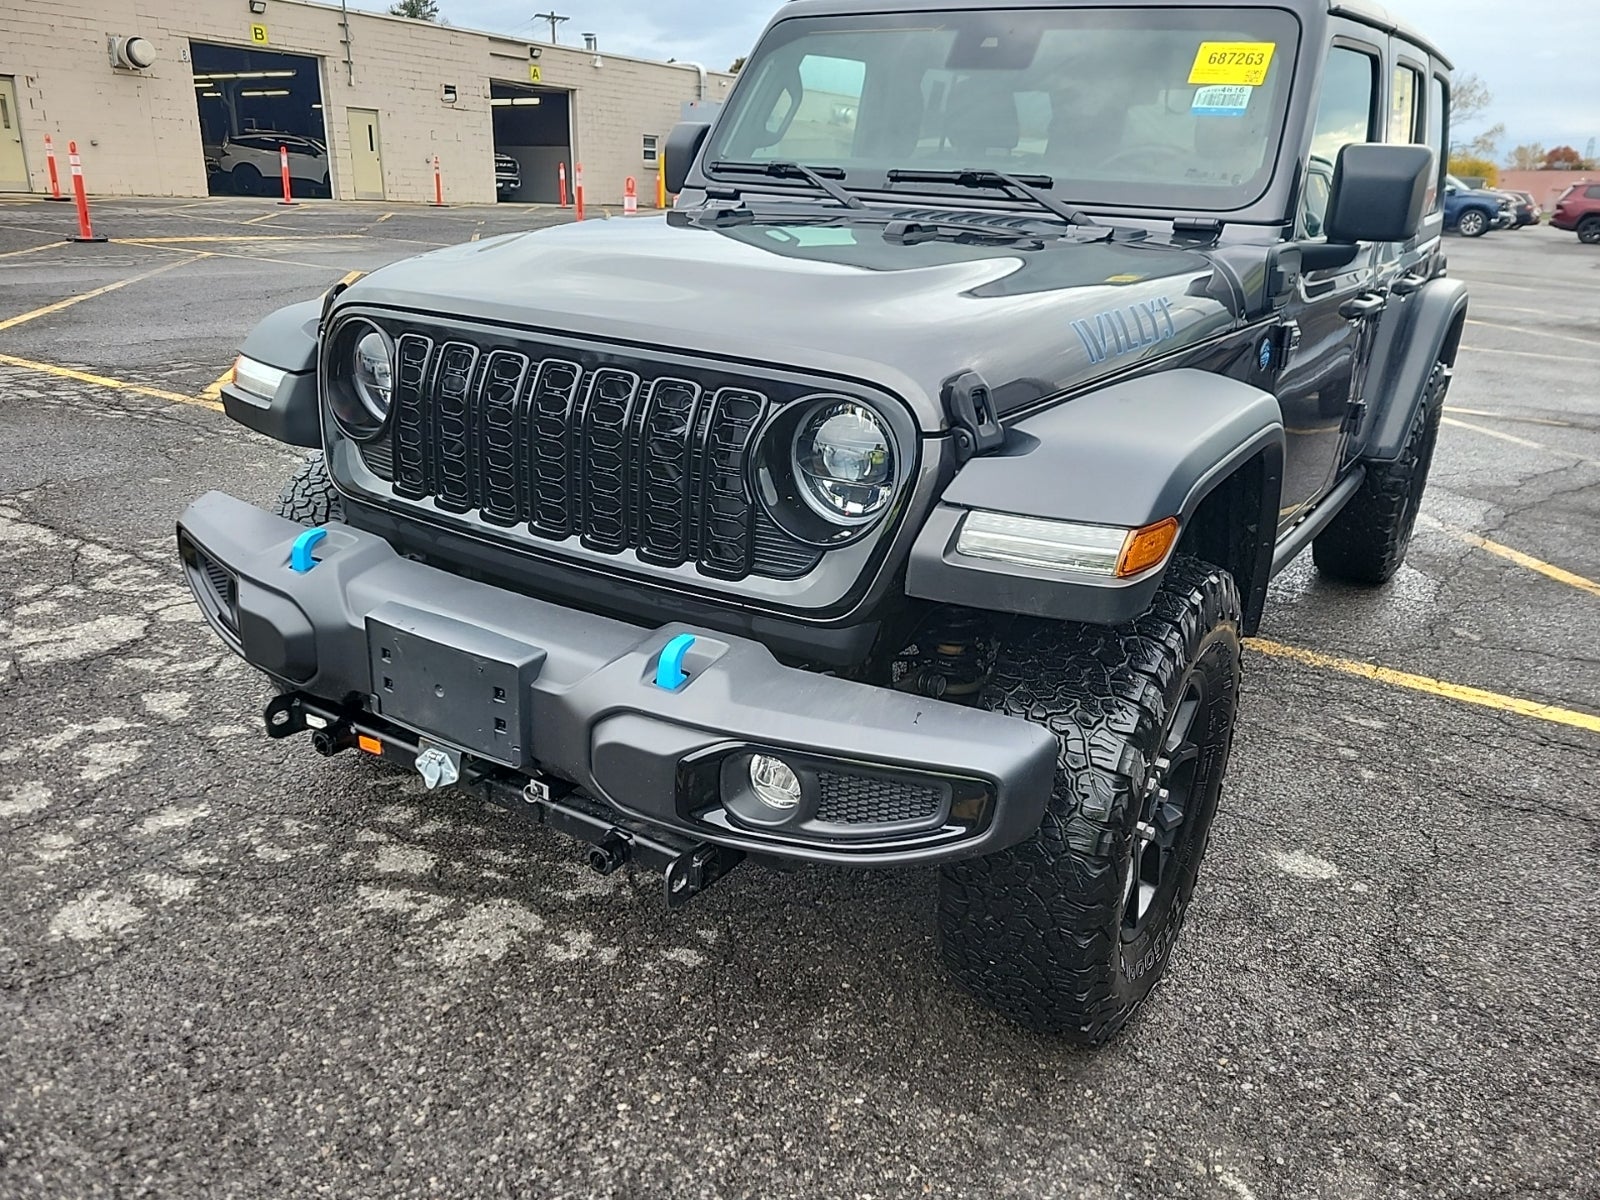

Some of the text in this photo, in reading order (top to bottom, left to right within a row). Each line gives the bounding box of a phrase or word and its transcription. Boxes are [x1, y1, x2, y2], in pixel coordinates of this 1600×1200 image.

[253, 27, 265, 41] B
[1208, 52, 1265, 66] 687263
[531, 68, 540, 80] A
